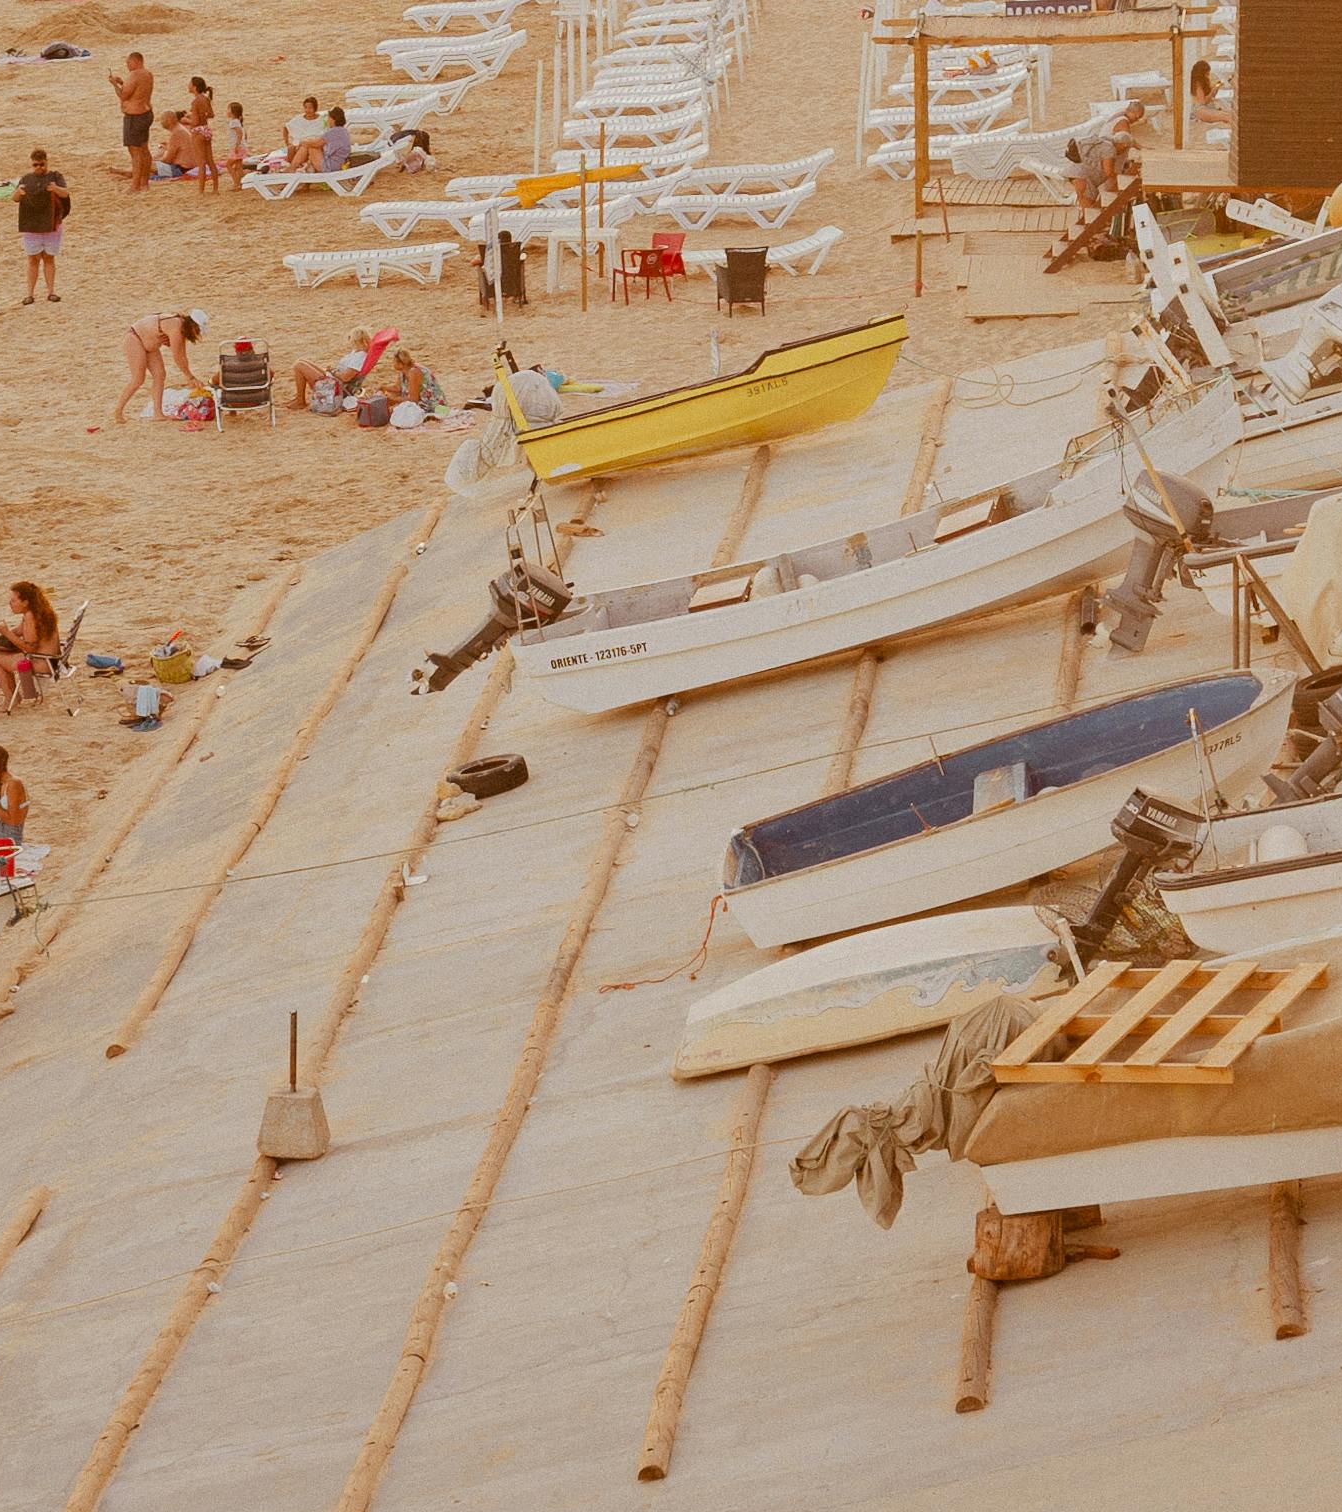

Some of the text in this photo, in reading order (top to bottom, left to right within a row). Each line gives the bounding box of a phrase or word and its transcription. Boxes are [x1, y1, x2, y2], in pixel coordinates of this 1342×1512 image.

[550, 653, 589, 670] ORIENTE
[595, 642, 648, 662] 123176-5PT
[1146, 806, 1178, 829] YAMAHA
